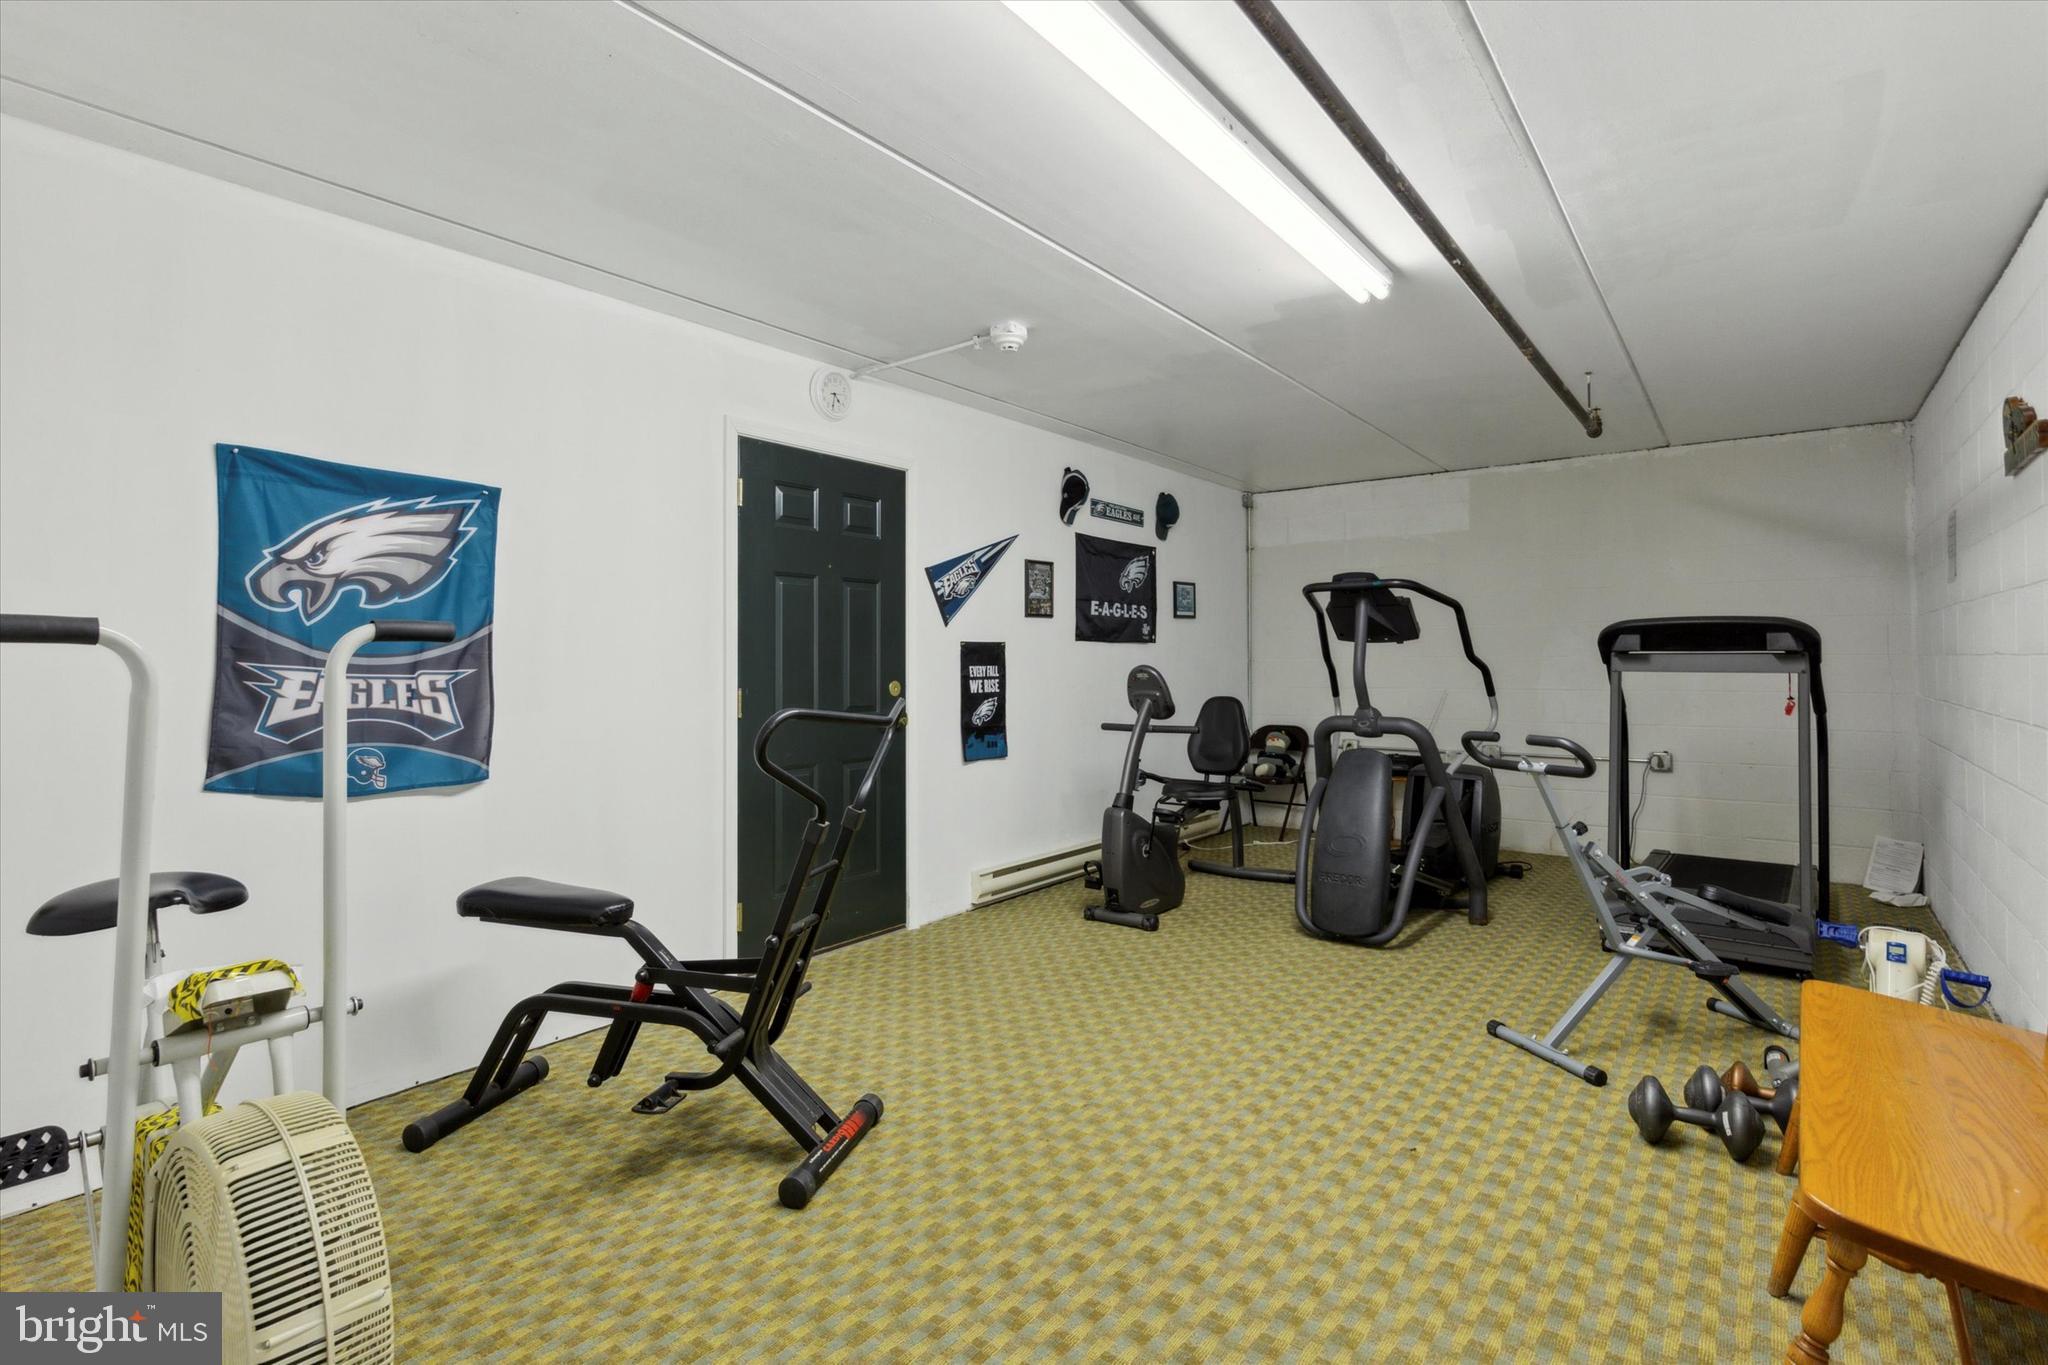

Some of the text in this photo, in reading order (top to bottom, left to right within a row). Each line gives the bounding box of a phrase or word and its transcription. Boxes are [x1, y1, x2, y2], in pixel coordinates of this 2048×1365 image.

[1106, 507, 1132, 521] EAGLES
[935, 555, 979, 599] EAGLES
[969, 665, 999, 677] EVERY FALL
[969, 679, 1000, 693] WE RISE
